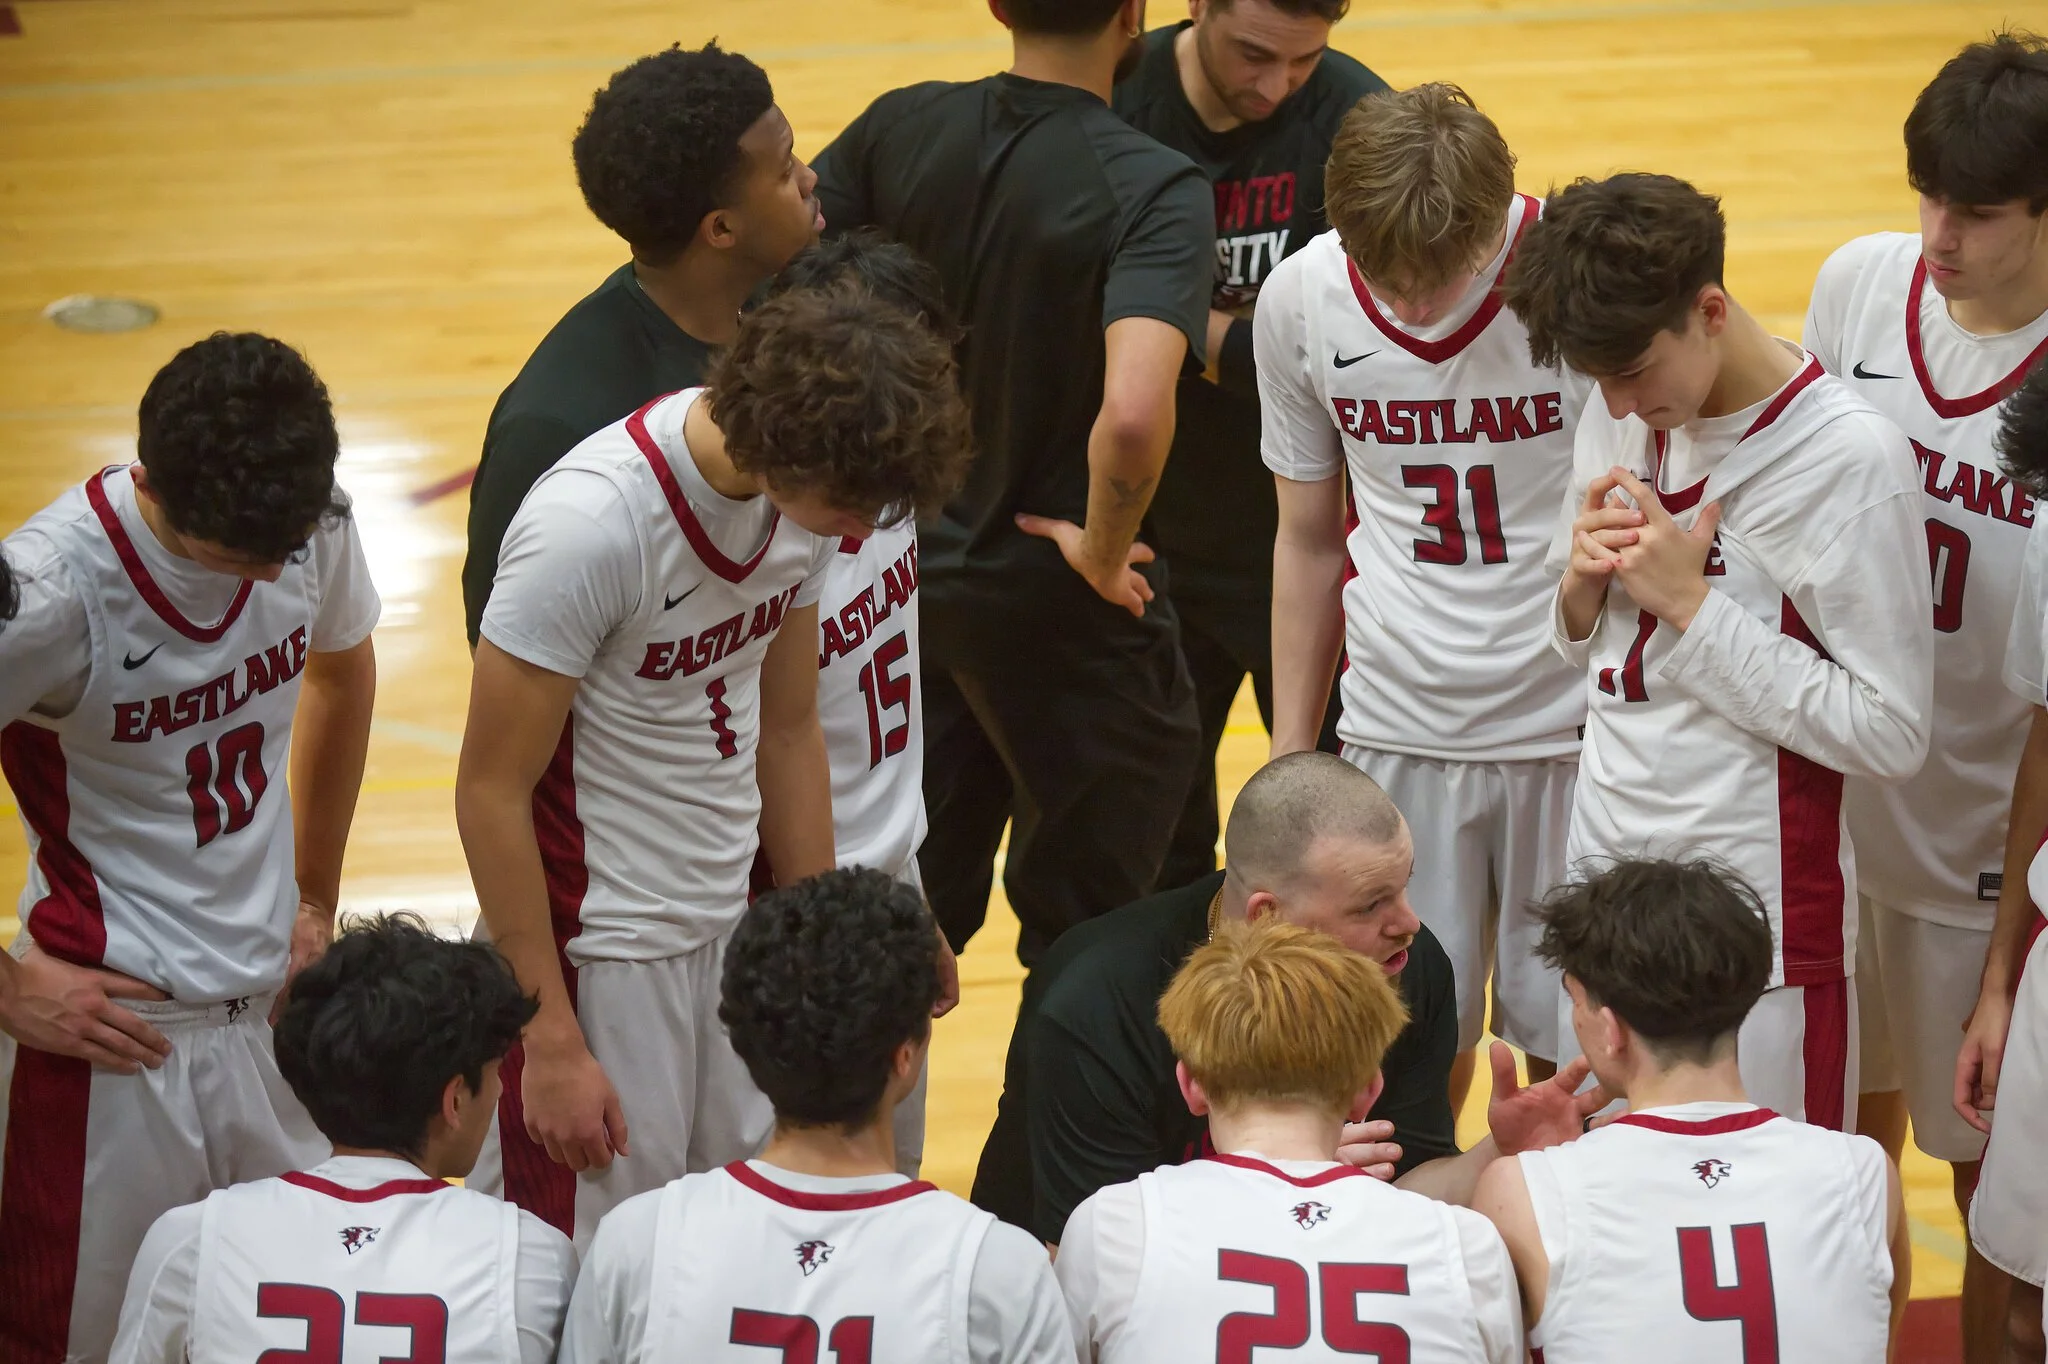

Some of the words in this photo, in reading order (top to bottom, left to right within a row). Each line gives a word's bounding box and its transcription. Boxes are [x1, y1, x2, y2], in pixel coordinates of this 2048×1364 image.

[1331, 391, 1563, 445] EASTLAKE
[1401, 463, 1508, 565] 31
[818, 538, 919, 670] ASTLAKE
[111, 624, 306, 743] EASTLAKE
[705, 676, 738, 760] 1
[859, 629, 911, 772] 15
[185, 721, 267, 848] 10
[1215, 1248, 1411, 1364] 25
[1676, 1222, 1780, 1364] 4
